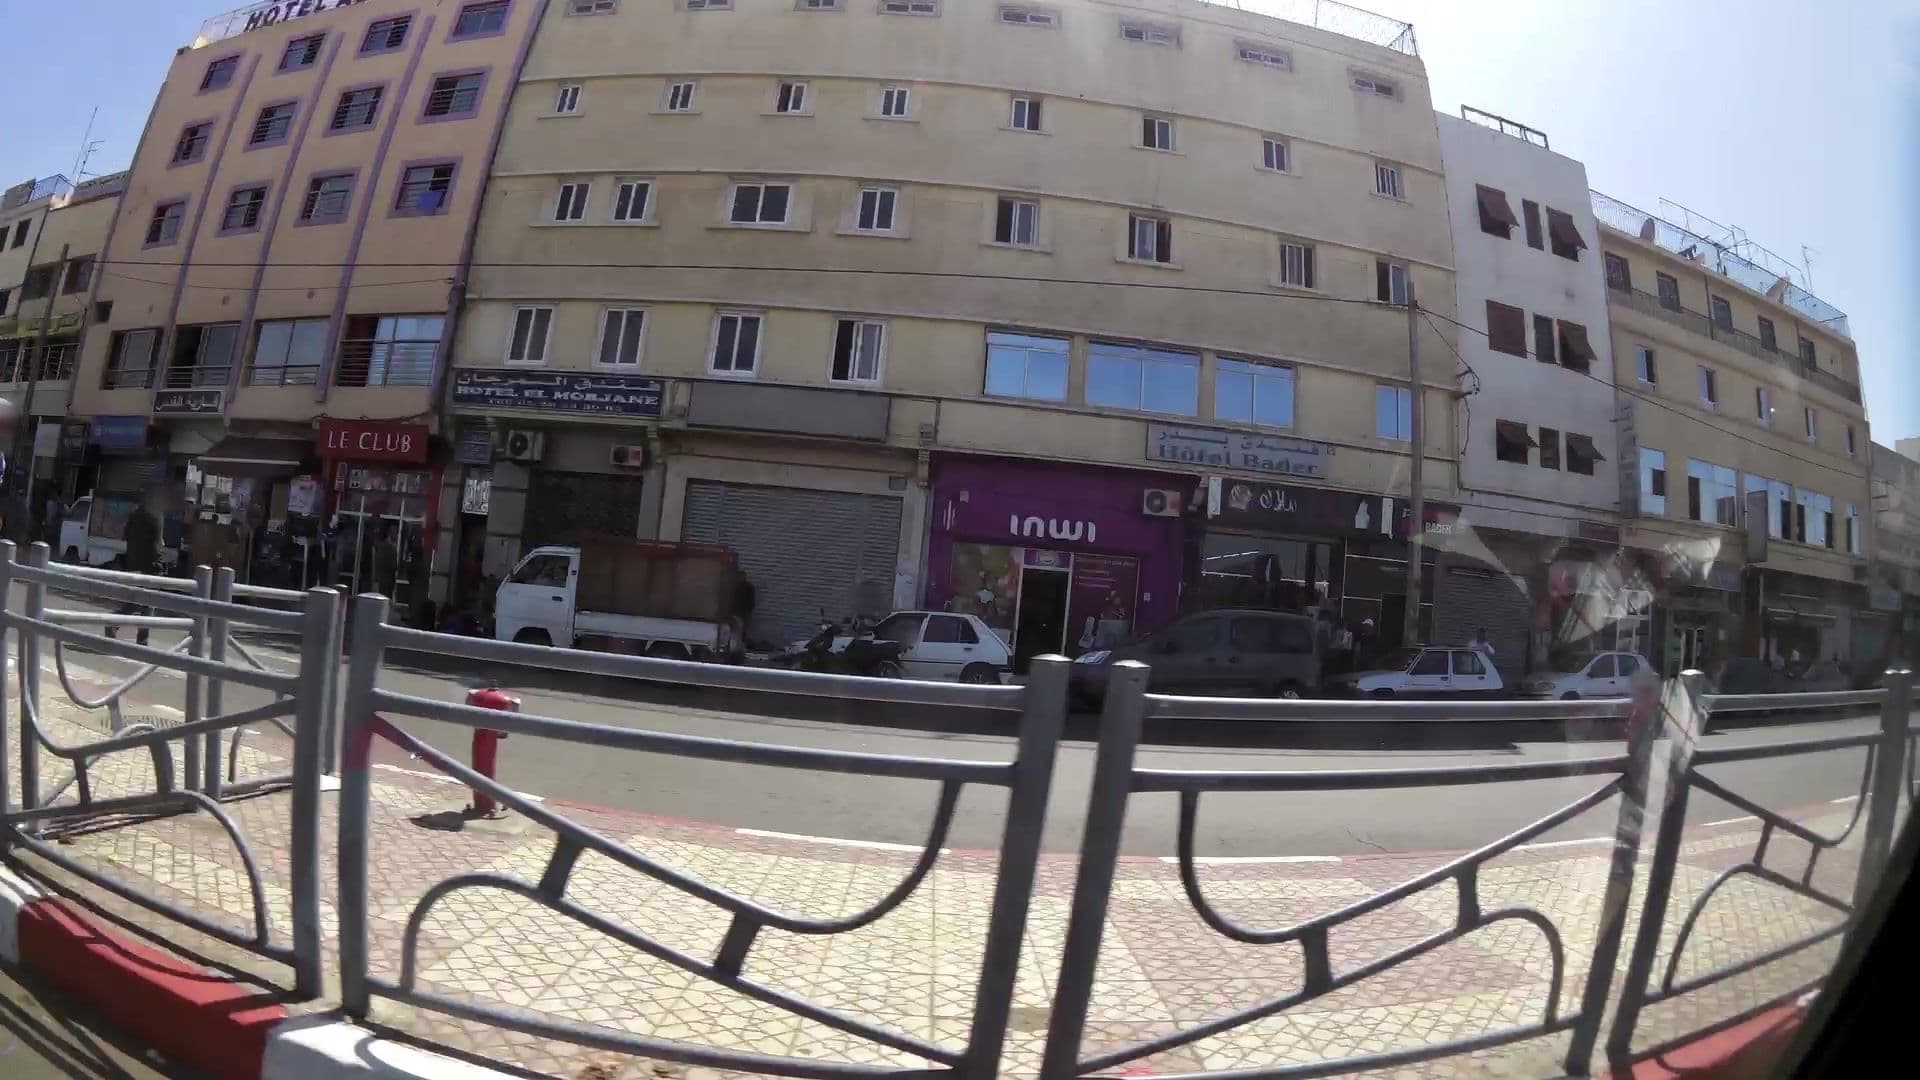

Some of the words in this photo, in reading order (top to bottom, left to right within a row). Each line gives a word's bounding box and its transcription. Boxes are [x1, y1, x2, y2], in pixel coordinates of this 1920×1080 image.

[243, 0, 326, 32] HOTEL
[456, 385, 519, 398] HOTEL
[524, 389, 550, 399] EL
[553, 391, 659, 405] MORJANE
[328, 431, 350, 449] LE
[359, 432, 411, 453] CLUB
[1242, 453, 1320, 475] Bader
[1010, 514, 1096, 543] inwi
